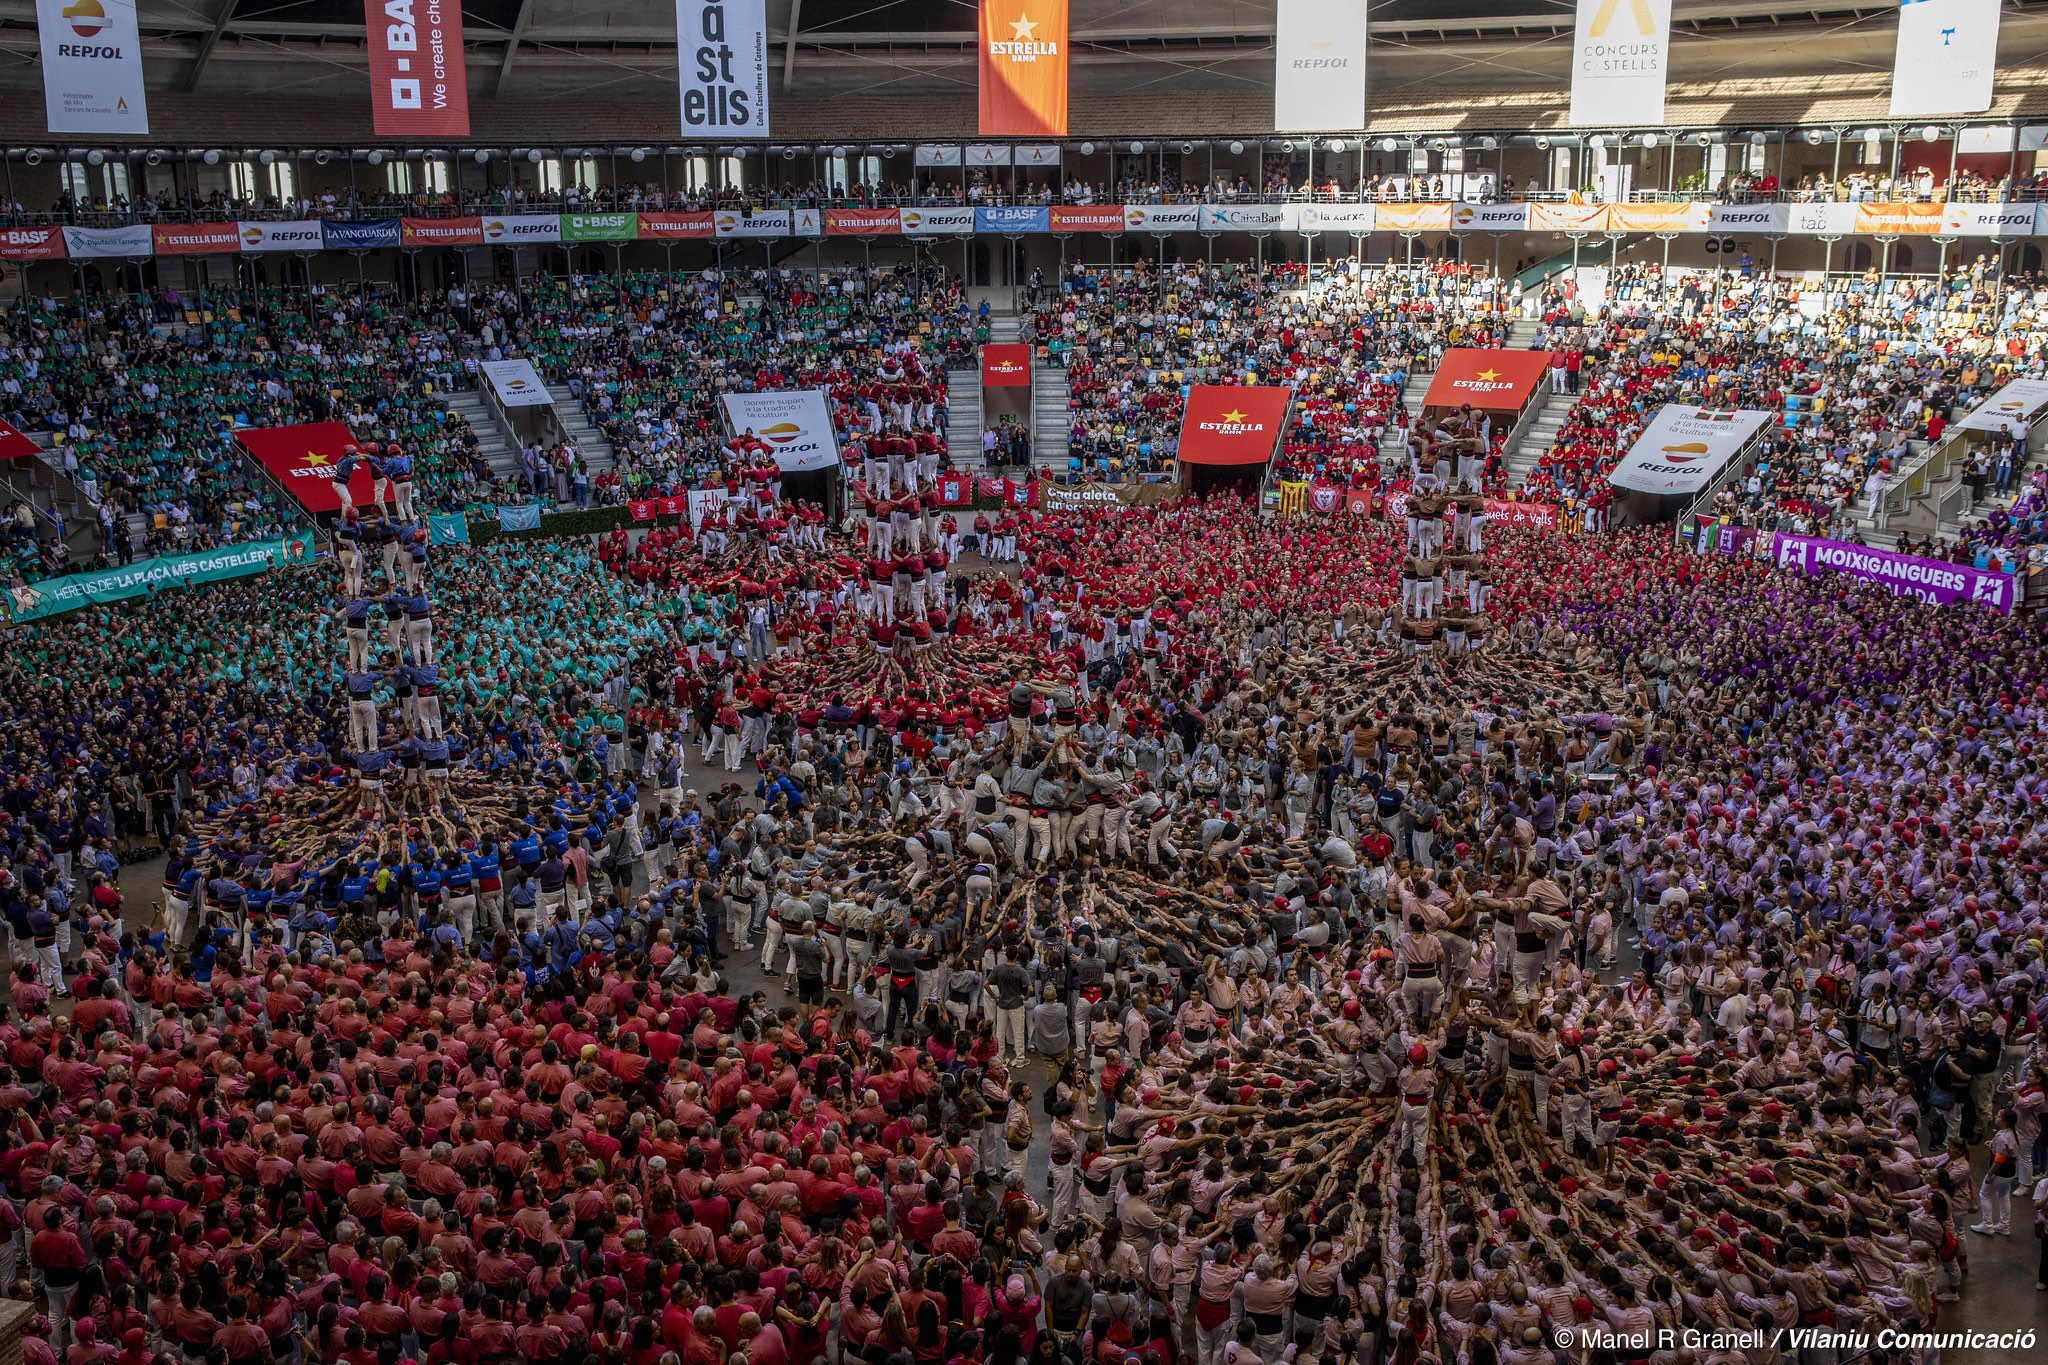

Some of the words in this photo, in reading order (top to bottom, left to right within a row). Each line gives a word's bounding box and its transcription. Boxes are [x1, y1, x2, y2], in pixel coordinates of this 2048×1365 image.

[58, 44, 123, 59] REPSOL
[754, 31, 763, 62] Catalunya
[990, 41, 1058, 55] ESTRELLA
[1584, 44, 1658, 56] CONCURS
[430, 29, 445, 79] create
[1292, 58, 1349, 68] REPSOL
[1583, 59, 1657, 71] CSTELLS
[755, 72, 763, 107] Castelleres
[432, 83, 447, 109] We
[683, 85, 750, 126] ells
[756, 108, 764, 127] Colles
[1004, 209, 1038, 219] BASF
[1061, 215, 1097, 223] ESTRELLA
[1099, 215, 1122, 223] DAMM
[1152, 213, 1197, 222] REPSOL
[1230, 211, 1285, 223] CaixaBank
[1481, 213, 1527, 221] REPSOL
[1720, 213, 1770, 223] REPSOL
[591, 216, 625, 227] BASF
[651, 221, 688, 231] ESTRELLA
[688, 220, 713, 230] DAMM
[743, 218, 788, 228] REPSOL
[838, 219, 875, 227] ESTRELLA
[875, 218, 898, 226] DAMM
[928, 216, 974, 225] REPSOL
[1977, 215, 2031, 225] REPSOL
[327, 229, 339, 238] LA
[339, 228, 397, 239] VANGUARDIA
[416, 228, 455, 237] ESTRELLA
[455, 227, 481, 236] DAMM
[512, 224, 559, 234] REPSOL
[9, 231, 48, 244] BASF
[87, 237, 118, 246] Diputació
[118, 238, 149, 246] Tarragona
[168, 235, 211, 245] ESTRELLA
[211, 234, 238, 244] DAMM
[271, 231, 320, 241] REPSOL
[22, 247, 51, 255] chemistry
[1452, 380, 1513, 389] ESTRELLA
[506, 388, 538, 396] REPSOL
[776, 398, 806, 406] suport
[763, 404, 797, 412] tradició
[1199, 422, 1263, 431] ESTRELLA
[1669, 425, 1679, 433] la
[1679, 427, 1714, 437] cultura
[1693, 421, 1729, 431] tradició
[774, 442, 820, 453] EPSOL
[1637, 462, 1705, 474] REPSOL
[1047, 487, 1080, 500] Cada
[1082, 489, 1119, 503] aleta,
[1513, 511, 1526, 521] de
[1529, 512, 1553, 526] Valls
[1814, 546, 1966, 591] MOIXIGANGUERS
[53, 580, 98, 601] HEREUS
[98, 578, 114, 593] DE
[114, 574, 134, 588] 'LA
[134, 567, 172, 585] PLAÇA
[172, 559, 198, 577] MÉS
[199, 548, 273, 572] CASTELLERA'
